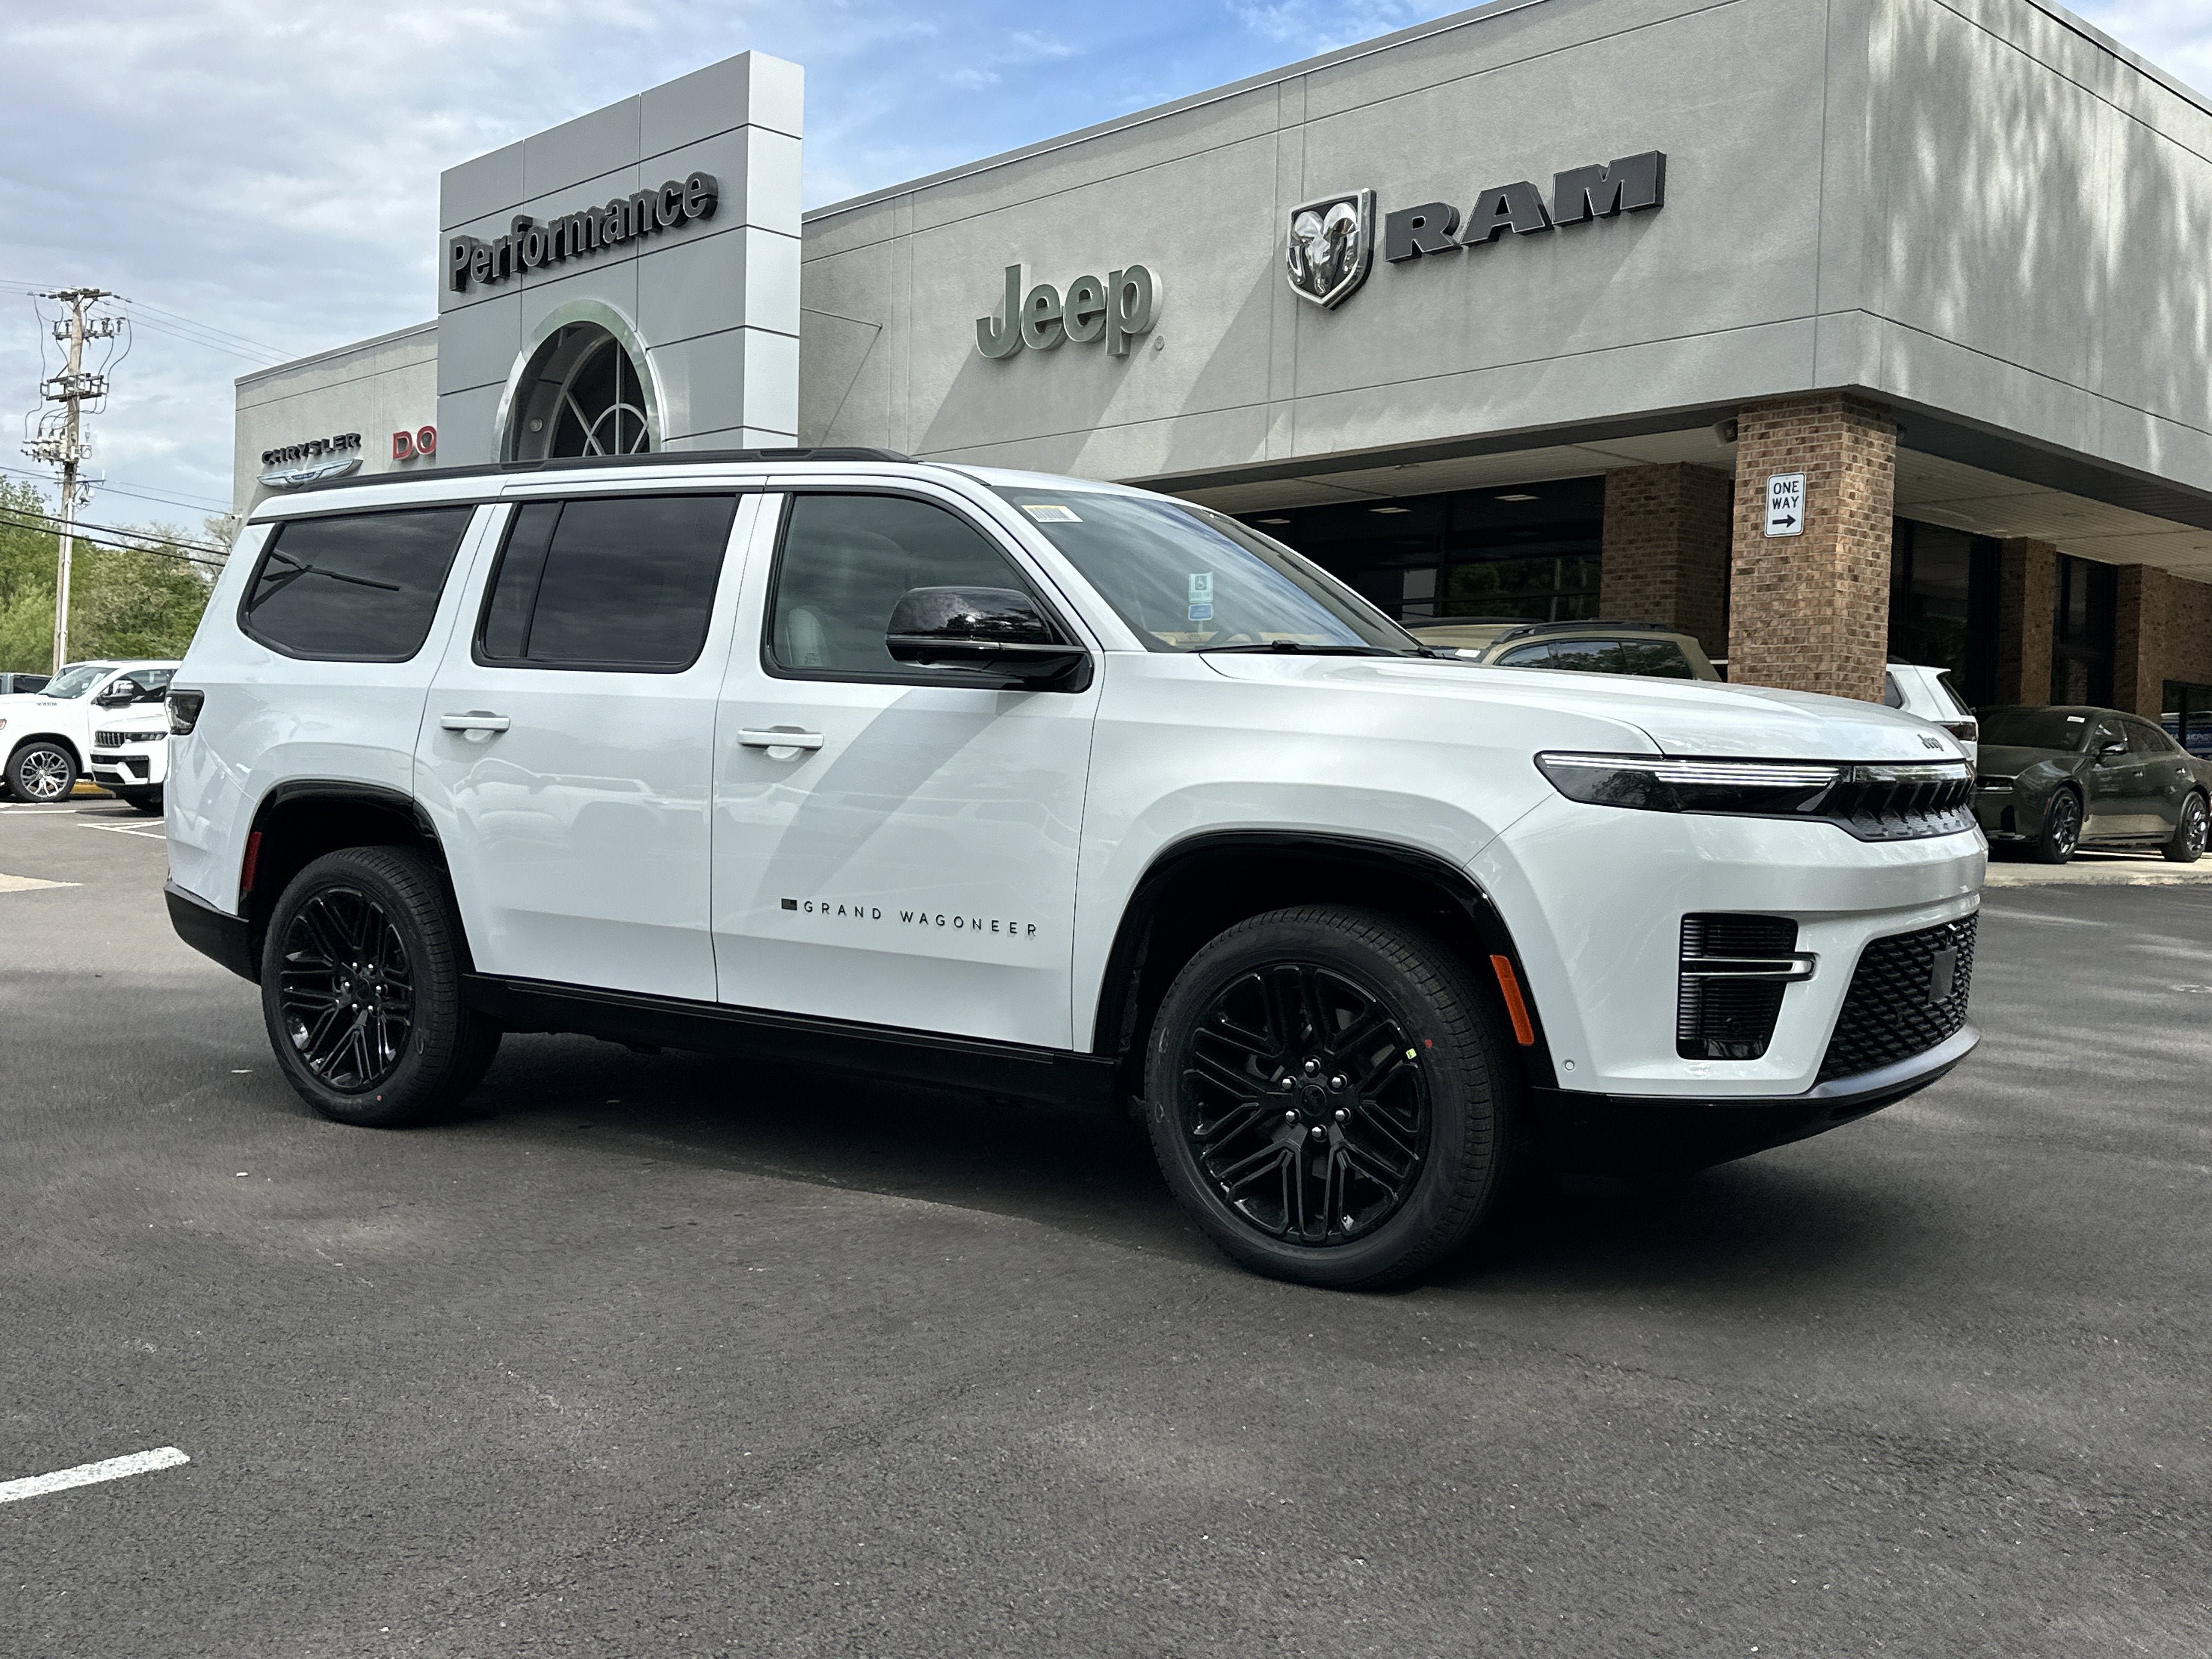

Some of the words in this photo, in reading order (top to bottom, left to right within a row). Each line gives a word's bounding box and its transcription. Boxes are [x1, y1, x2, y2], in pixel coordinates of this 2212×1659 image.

[1384, 150, 1666, 263] RAM
[449, 171, 718, 292] Performance
[976, 264, 1161, 358] Jeep
[262, 433, 361, 465] CHRYSLER
[1772, 495, 1799, 510] WAY
[1774, 481, 1799, 495] ONE
[804, 901, 882, 920] GRAND
[900, 911, 1037, 936] WAGONEER
